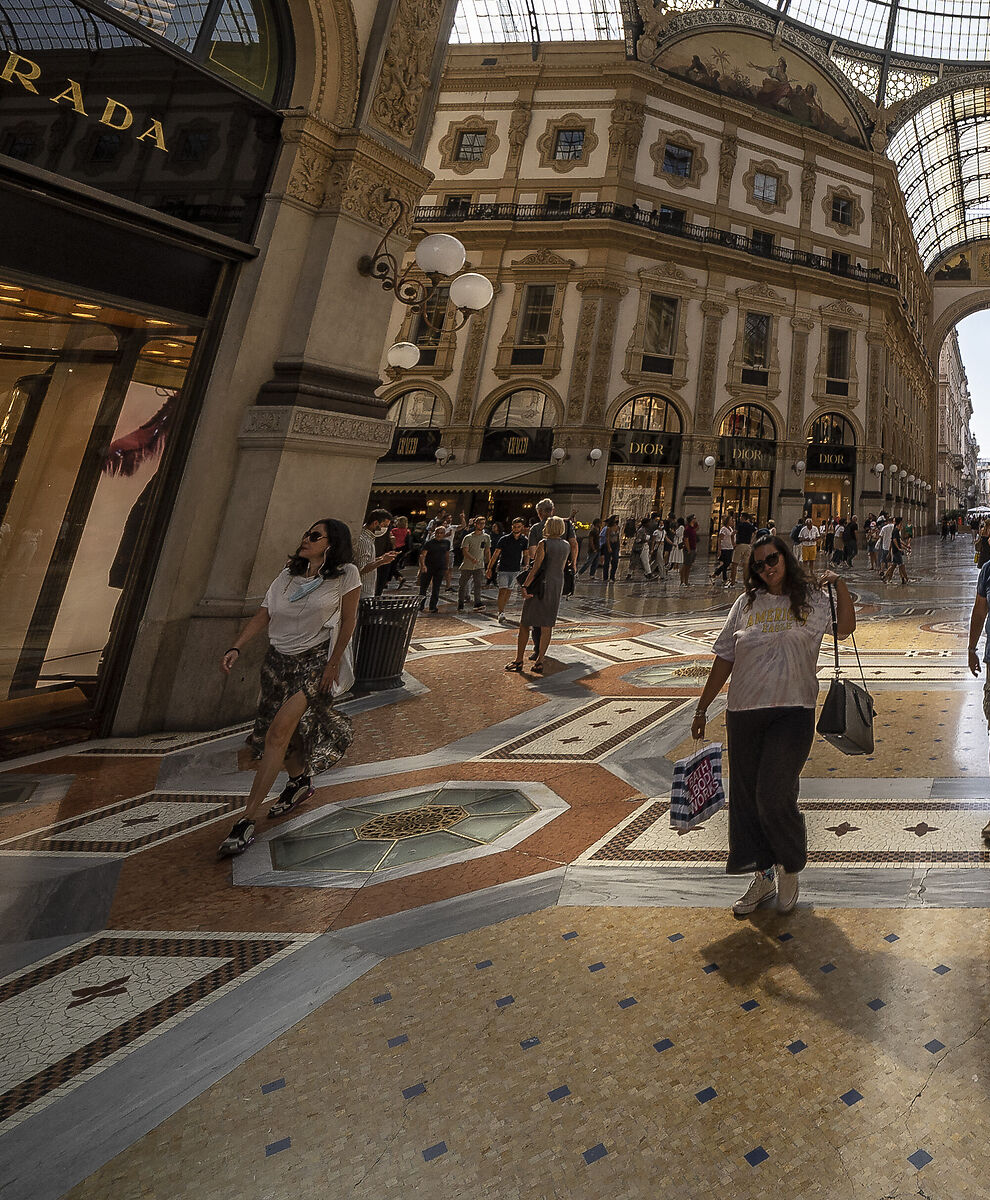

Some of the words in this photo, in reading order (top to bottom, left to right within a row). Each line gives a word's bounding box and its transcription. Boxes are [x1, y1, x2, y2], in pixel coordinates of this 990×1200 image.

[0, 50, 169, 152] RADA
[629, 442, 664, 456] DIOR
[732, 448, 762, 461] DIOR
[819, 453, 845, 465] DIOR
[746, 607, 809, 627] AMERIC
